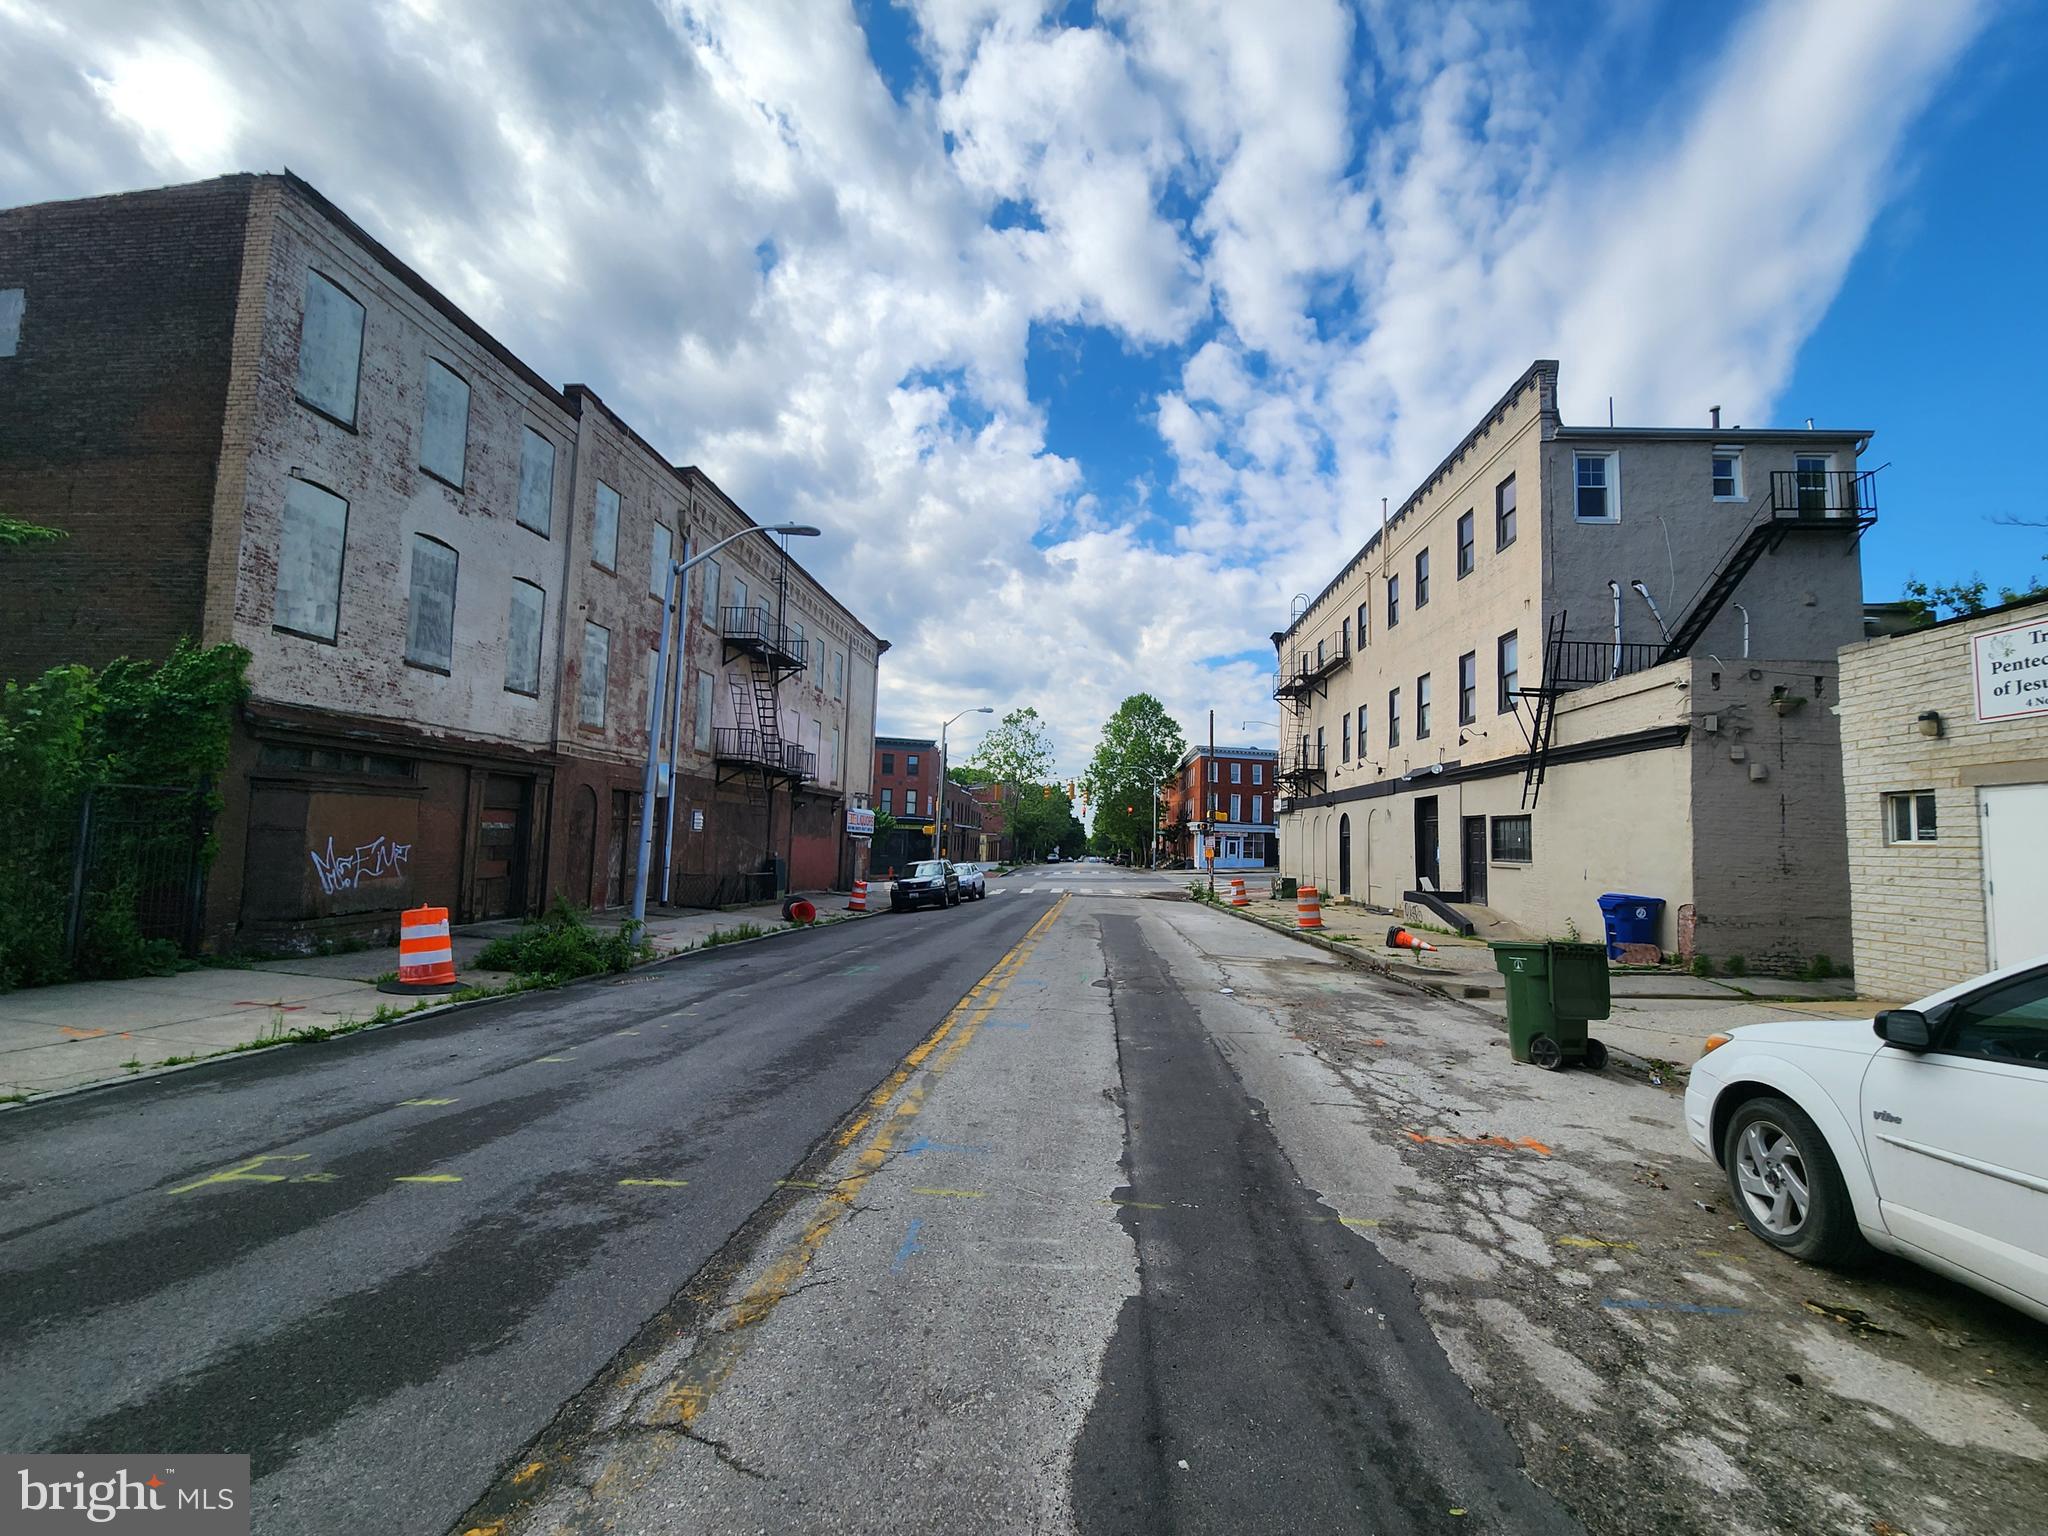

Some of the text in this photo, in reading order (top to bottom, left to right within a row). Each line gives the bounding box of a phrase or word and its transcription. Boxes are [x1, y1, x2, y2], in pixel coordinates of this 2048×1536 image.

[1991, 655, 2048, 675] Pentec
[1993, 680, 2011, 696] of
[1873, 1110, 1902, 1124] vibe
